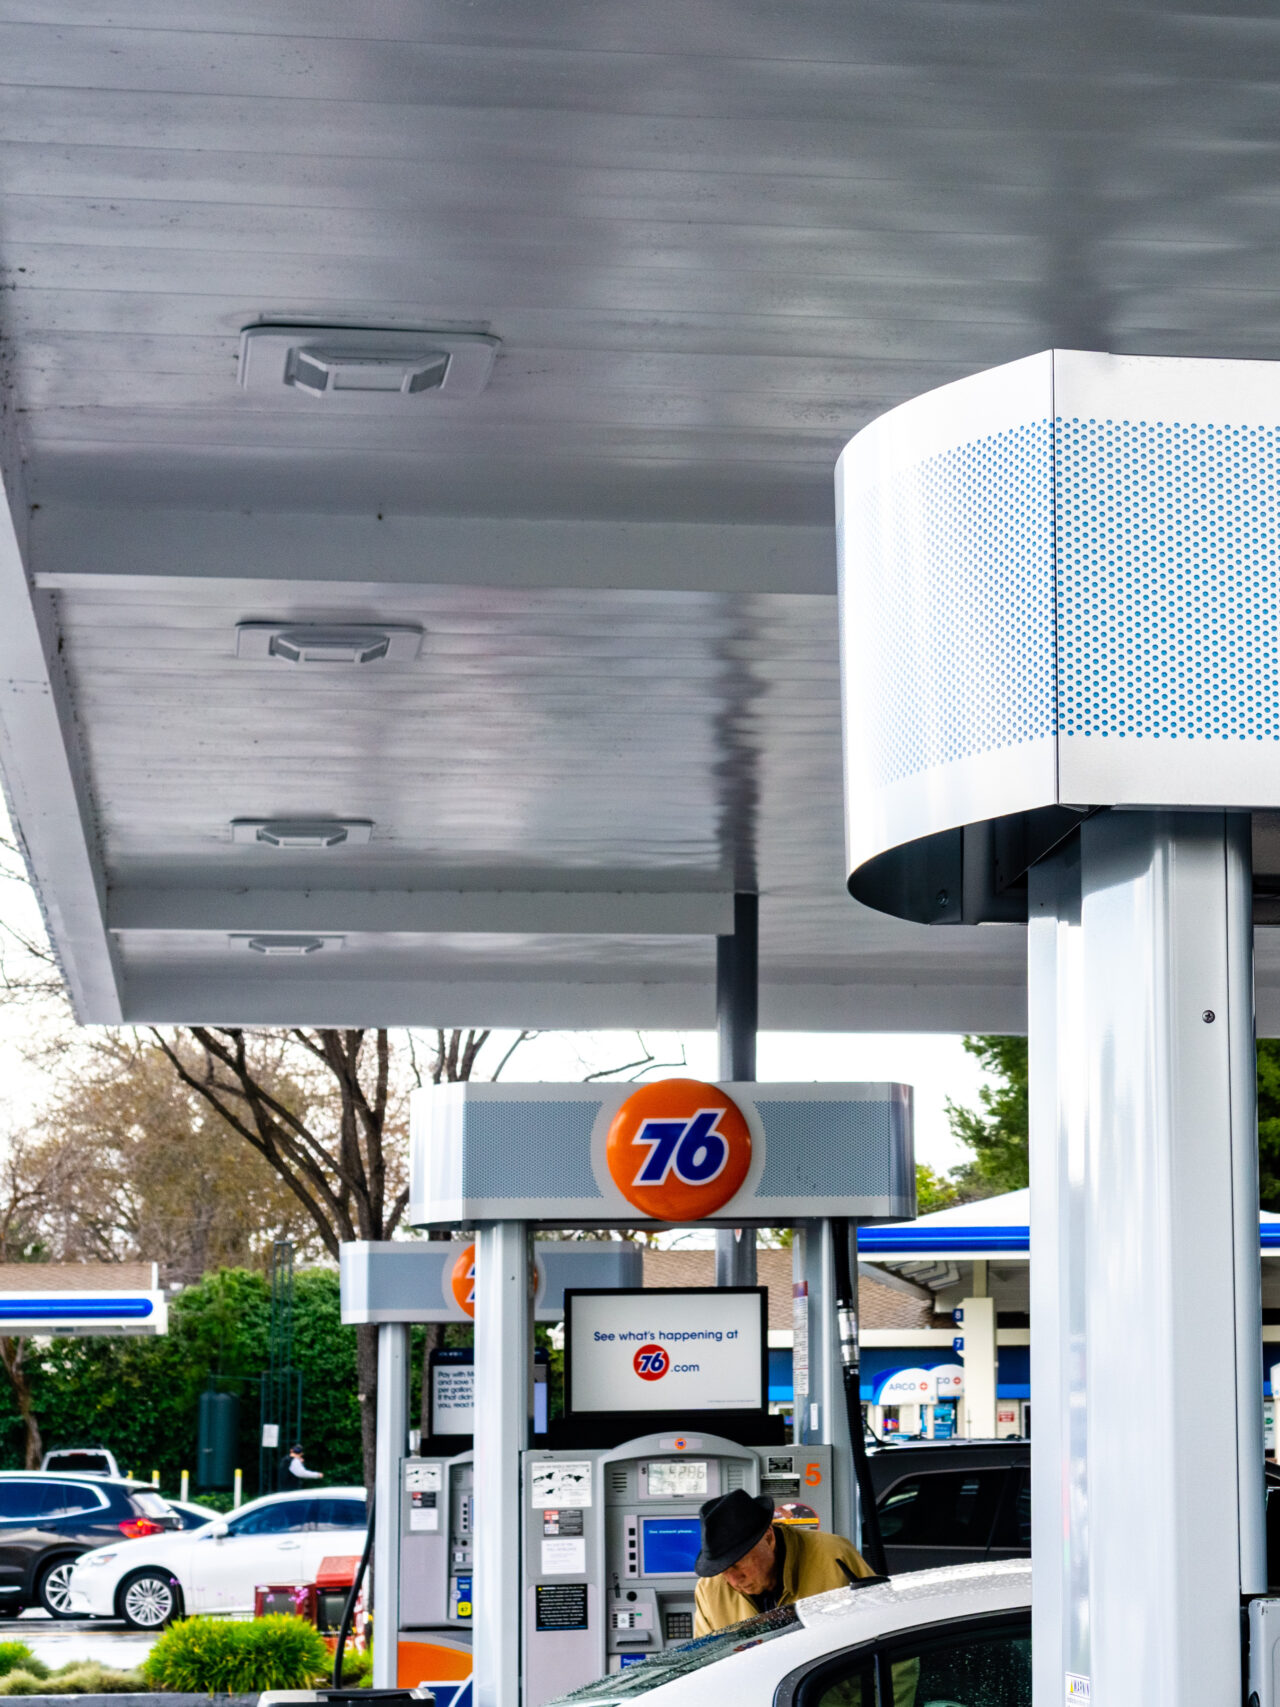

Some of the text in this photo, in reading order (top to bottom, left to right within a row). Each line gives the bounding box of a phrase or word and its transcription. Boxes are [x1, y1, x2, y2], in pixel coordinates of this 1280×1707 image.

[631, 1108, 729, 1186] 76
[594, 1330, 738, 1342] See what's happening at
[956, 1340, 962, 1348] 7
[638, 1351, 699, 1373] 76 .com
[889, 1383, 916, 1391] ARCO
[805, 1463, 822, 1486] 5
